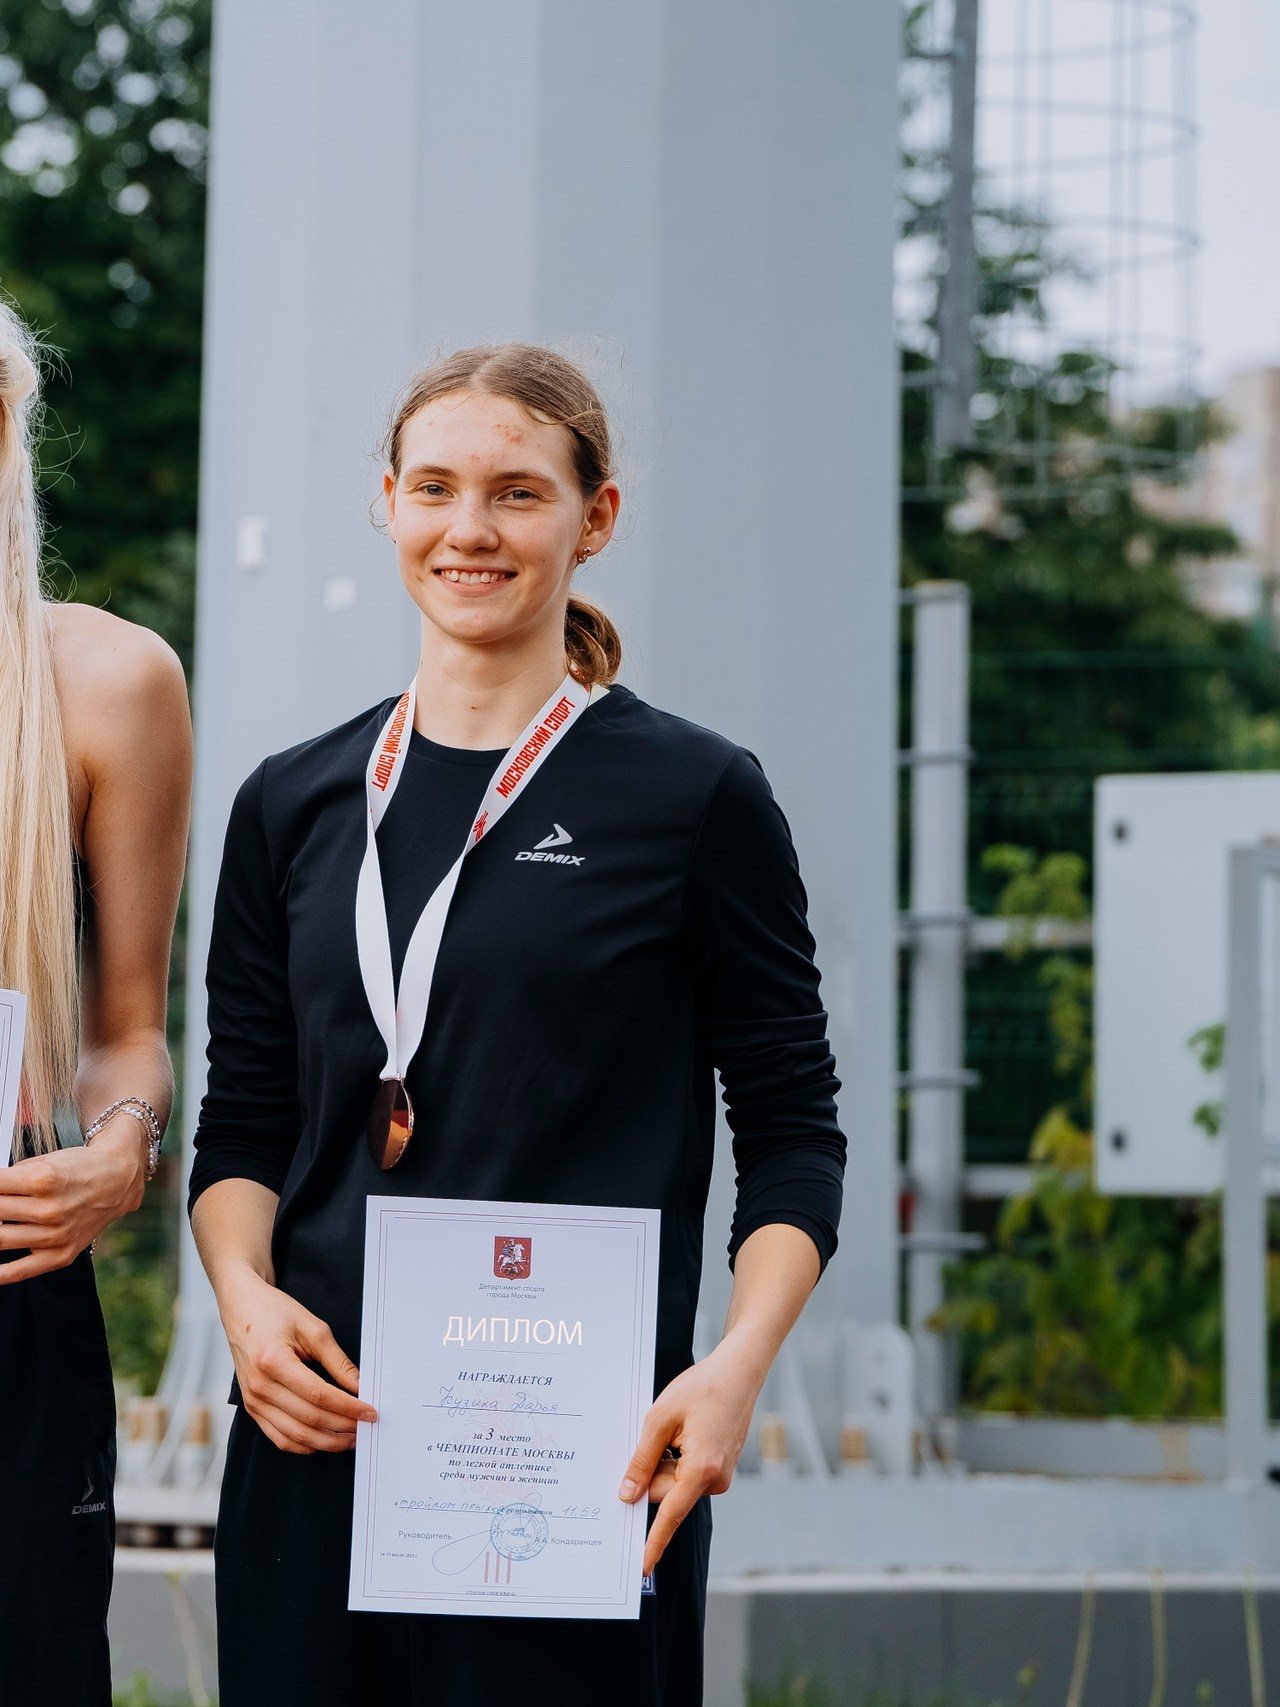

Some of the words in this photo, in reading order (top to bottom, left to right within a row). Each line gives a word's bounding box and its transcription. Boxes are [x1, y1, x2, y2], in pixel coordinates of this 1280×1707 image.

[495, 725, 553, 798] МОСКОВСКИЙ
[543, 696, 576, 731] СПОРТ
[372, 754, 396, 791] СПОРТ
[515, 851, 586, 867] DEMIX
[478, 1283, 521, 1292] Департамент
[522, 1285, 545, 1293] спорта
[442, 1315, 583, 1347] ДИПЛОМ
[458, 1371, 553, 1386] НАГРАЖДАЕТСЯ
[472, 1432, 483, 1440] за
[485, 1427, 495, 1441] 3
[497, 1434, 531, 1443] место
[436, 1442, 520, 1457] ЧЕМПИОНАТЕ
[521, 1448, 576, 1460] МОСКВЫ
[448, 1459, 461, 1467] по
[463, 1459, 497, 1469] легкой
[499, 1463, 552, 1472] атлетике
[439, 1470, 465, 1480] среди
[467, 1473, 507, 1483] мужчин
[517, 1476, 559, 1486] женщин
[71, 1501, 106, 1515] DEMIX
[398, 1530, 452, 1541] Руководитель
[550, 1537, 603, 1547] Кондаранцев
